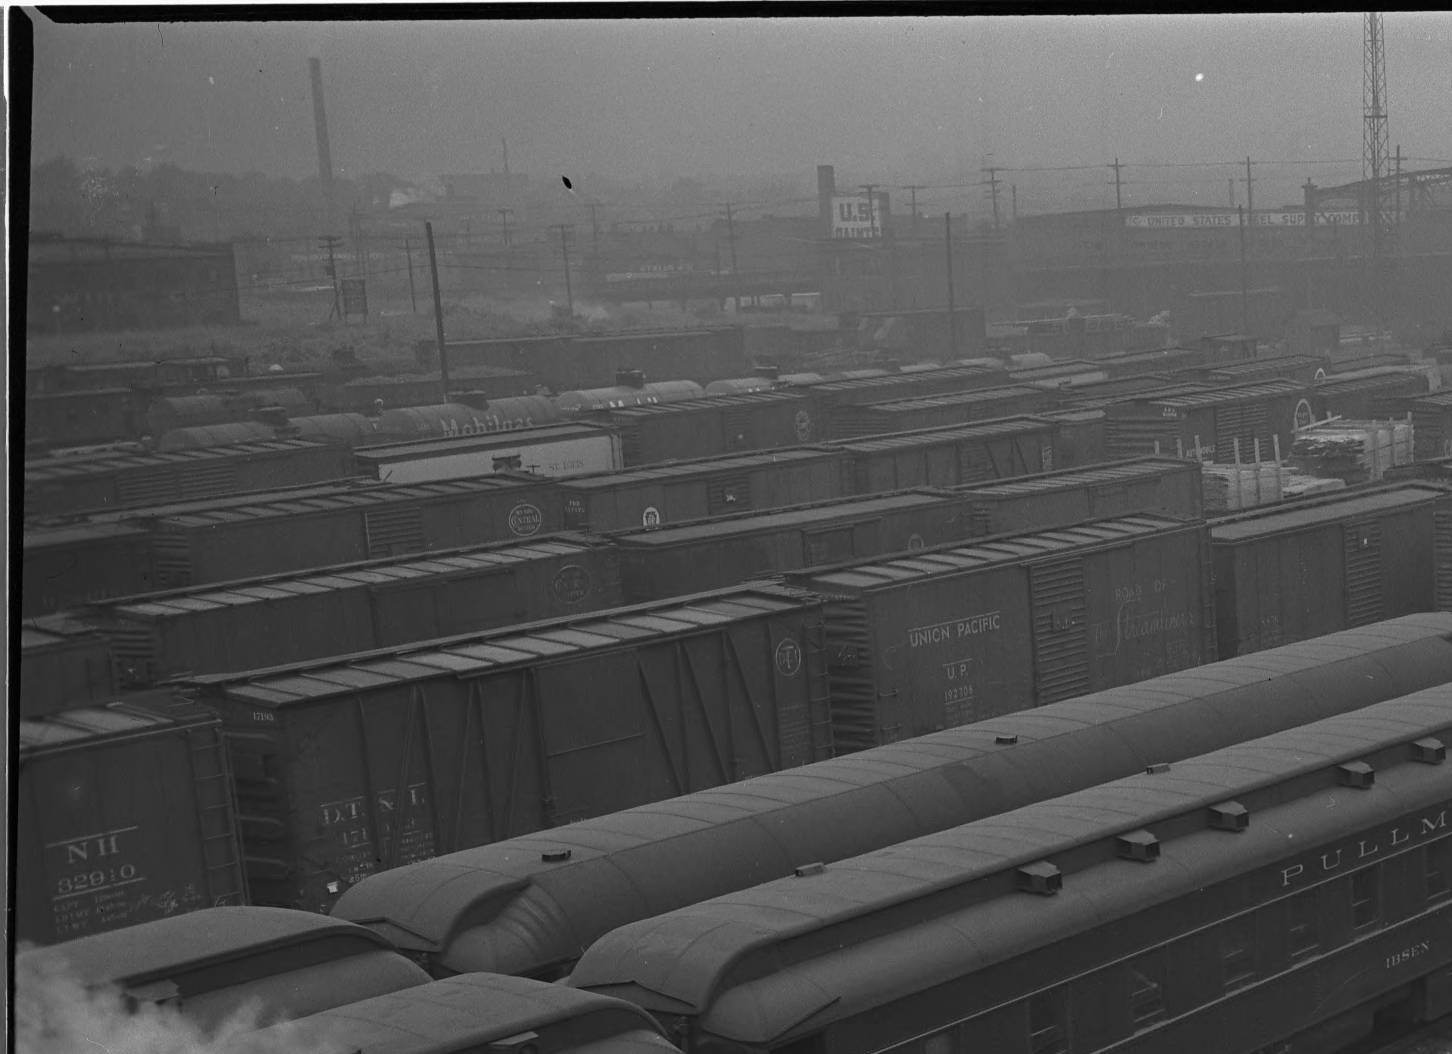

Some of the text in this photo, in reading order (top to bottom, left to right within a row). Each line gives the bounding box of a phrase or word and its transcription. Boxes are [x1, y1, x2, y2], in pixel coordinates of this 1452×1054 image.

[1193, 215, 1232, 226] STATES
[909, 614, 1000, 648] UNION PACIFIC
[57, 863, 136, 895] 32910
[1385, 939, 1430, 969] IBSEN
